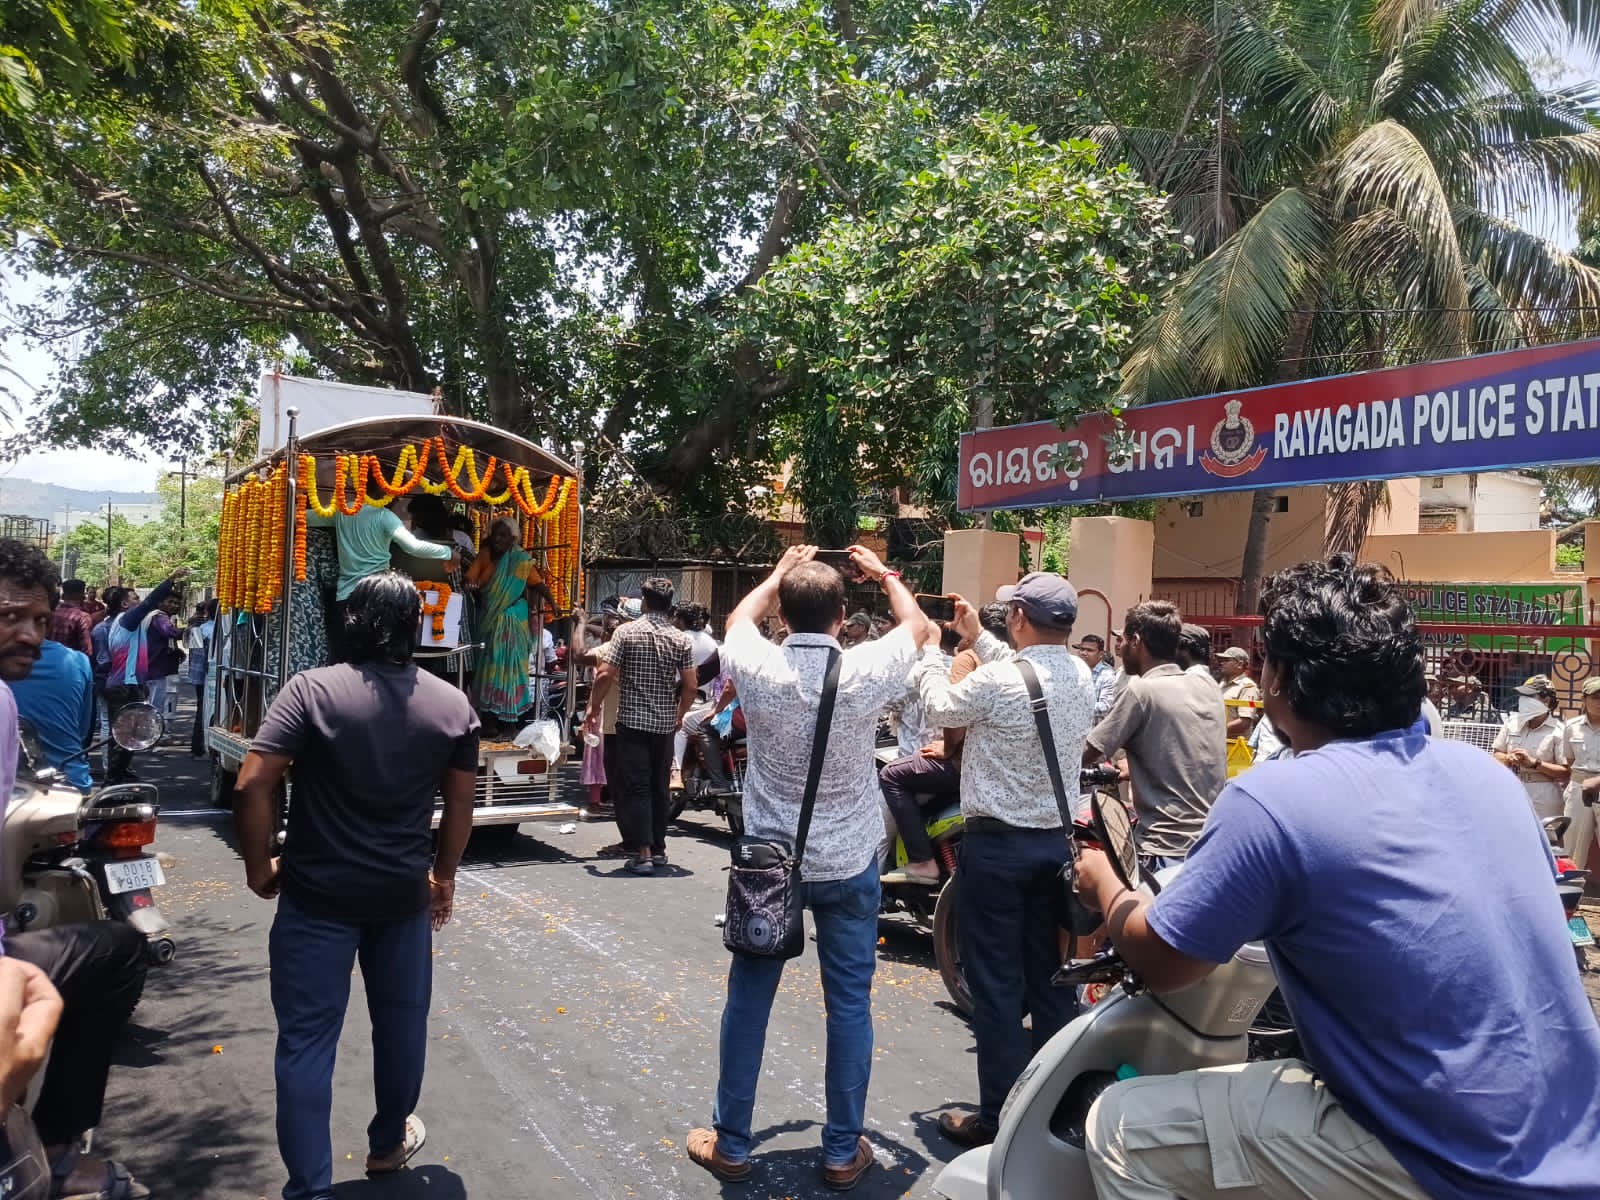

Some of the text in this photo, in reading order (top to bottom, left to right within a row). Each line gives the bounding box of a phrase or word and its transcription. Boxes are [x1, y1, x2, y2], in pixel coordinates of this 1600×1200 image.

[1273, 372, 1600, 459] RAYAGADA POLICE STAT
[1474, 593, 1558, 626] STATION
